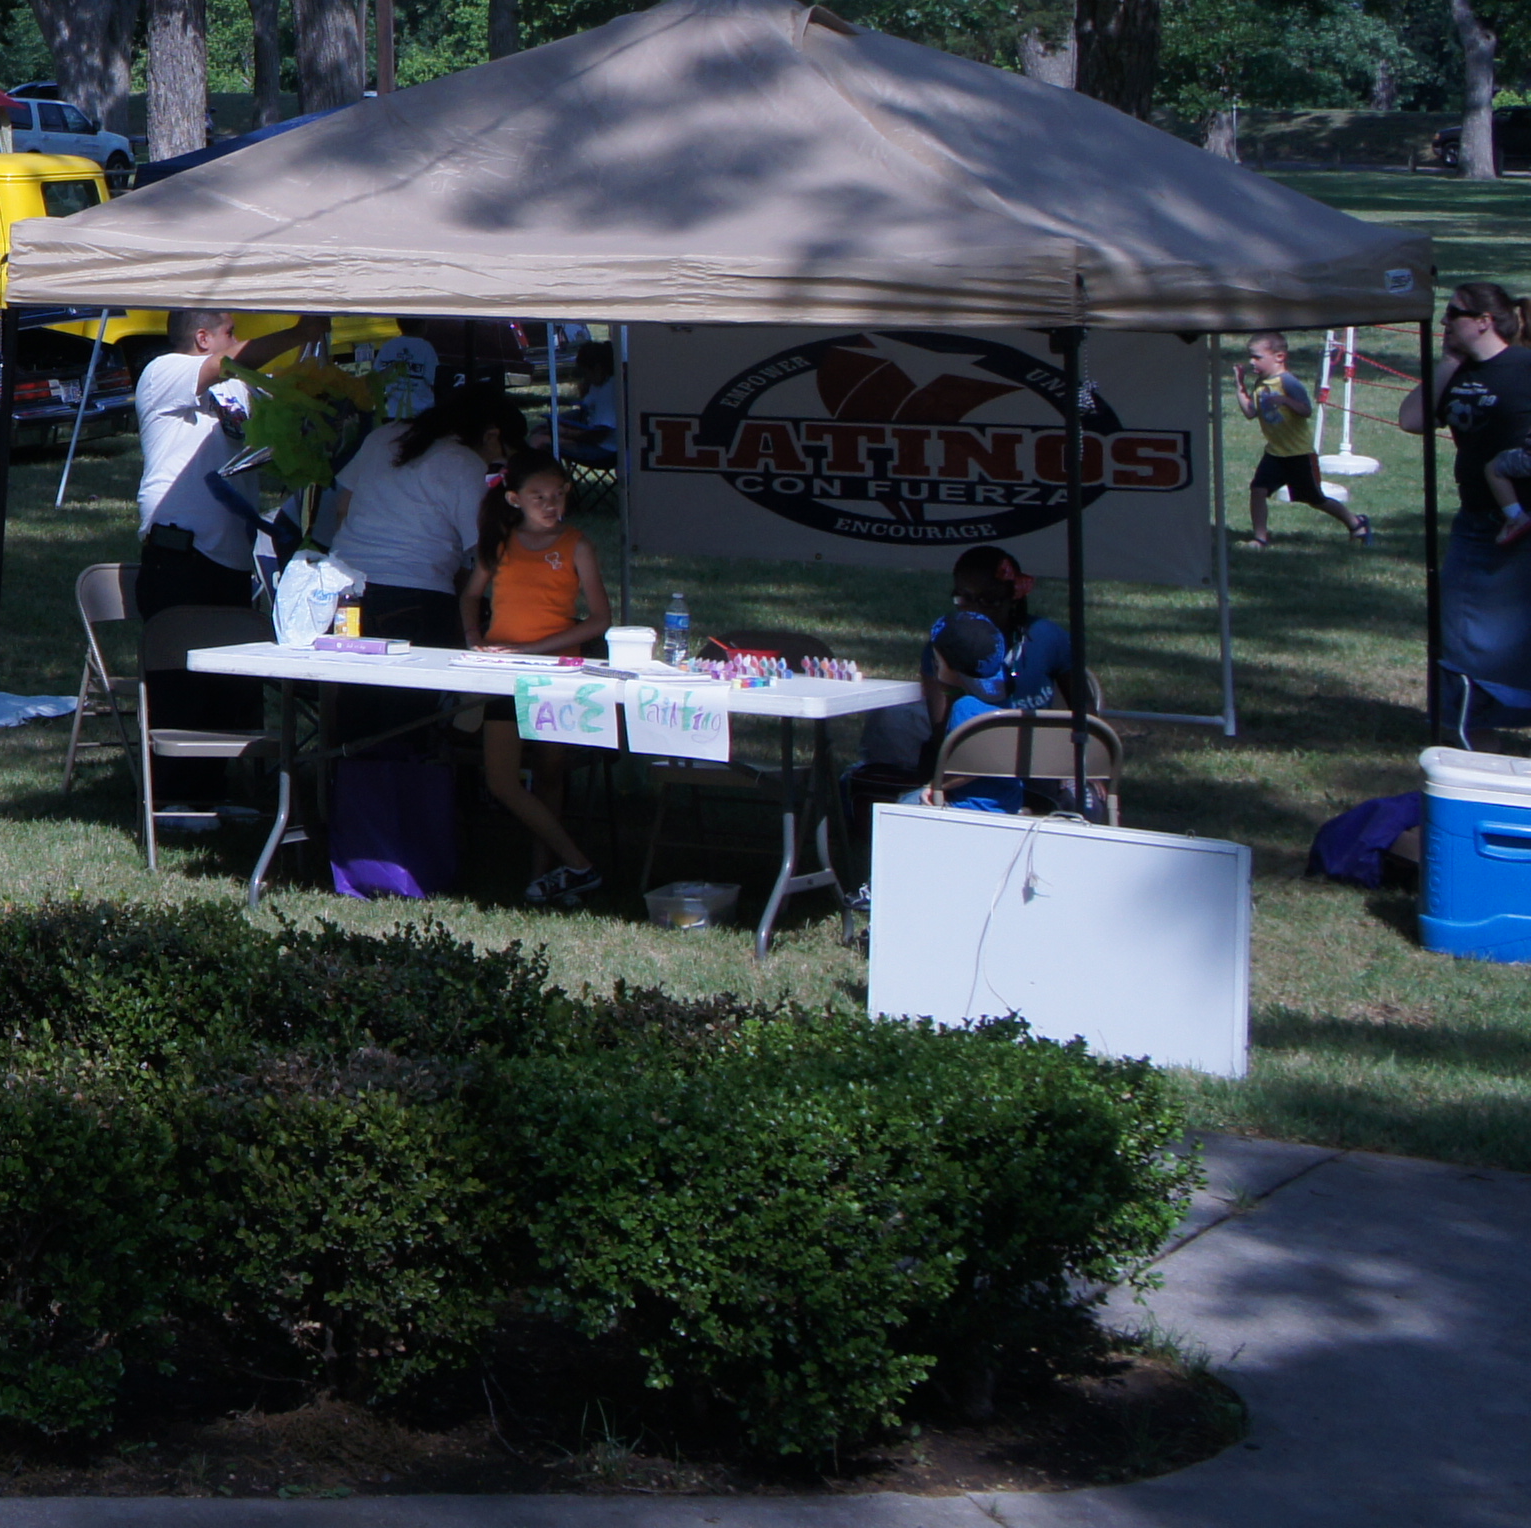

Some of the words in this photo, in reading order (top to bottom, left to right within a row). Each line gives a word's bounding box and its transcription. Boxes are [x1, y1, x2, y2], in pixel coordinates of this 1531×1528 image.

[719, 355, 812, 410] EMPOWER
[642, 414, 1191, 491] LATINOS
[735, 475, 844, 497] CON
[833, 517, 998, 540] ENCOURAGE
